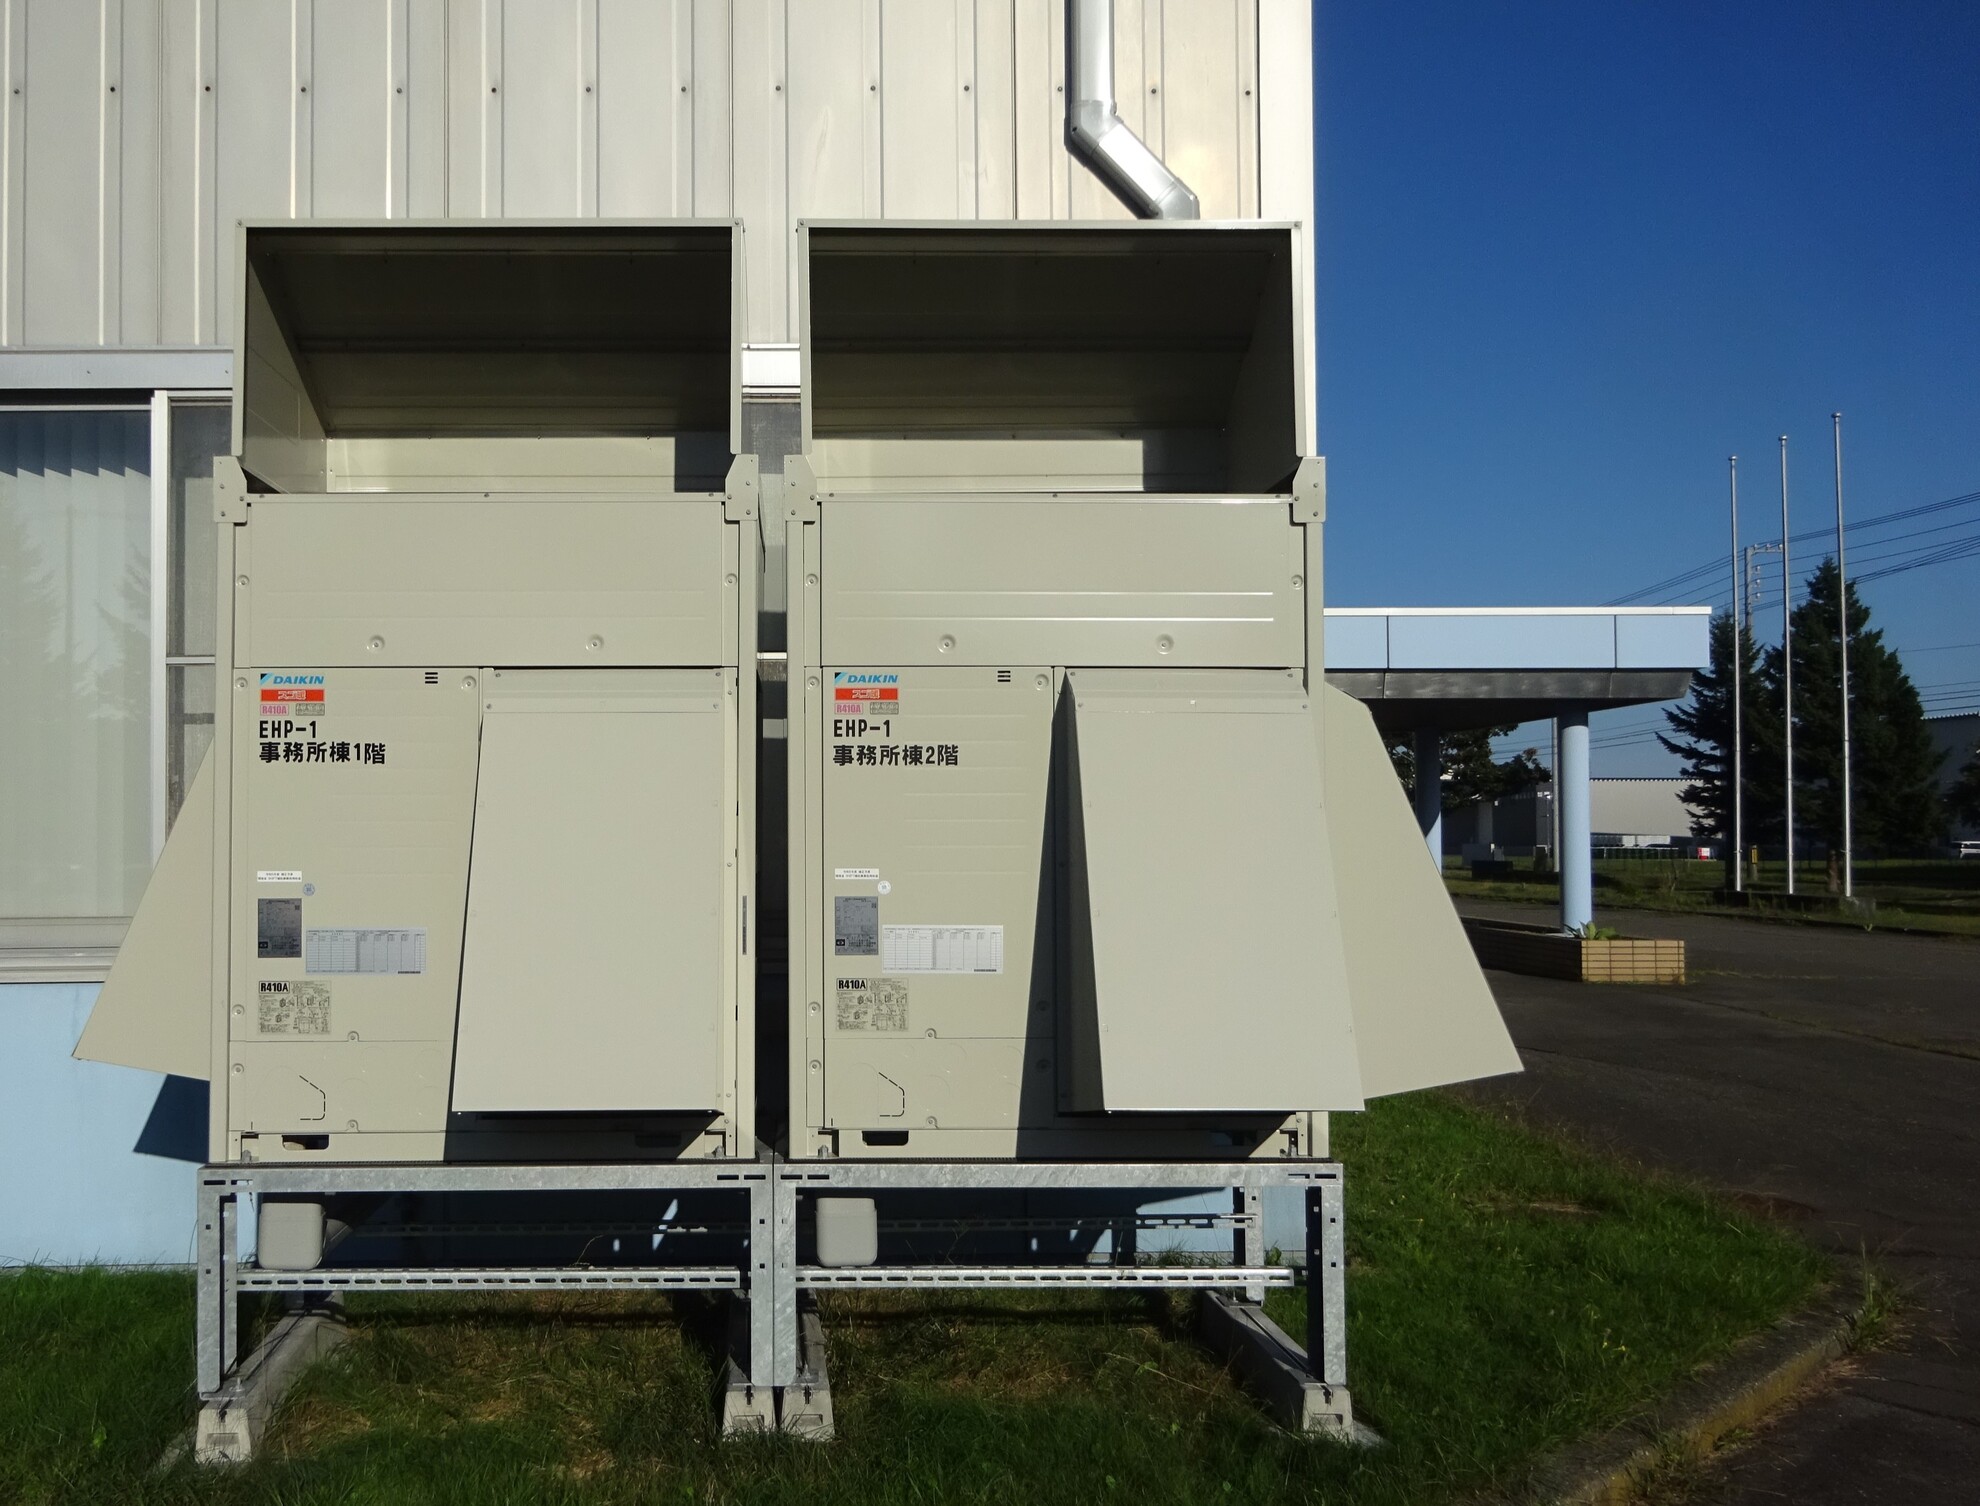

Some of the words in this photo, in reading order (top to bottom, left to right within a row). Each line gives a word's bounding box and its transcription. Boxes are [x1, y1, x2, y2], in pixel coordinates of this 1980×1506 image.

[273, 675, 324, 685] DAIKIN
[847, 674, 899, 684] DAIKIN
[262, 705, 287, 715] R410A
[836, 704, 861, 713] R410A
[259, 720, 316, 739] EHP-1
[833, 719, 890, 738] EHP-1
[259, 741, 386, 765] 事務所棟1階
[833, 744, 959, 767] 事務所棟2階
[260, 982, 289, 992] R410A
[838, 979, 866, 989] R410A
